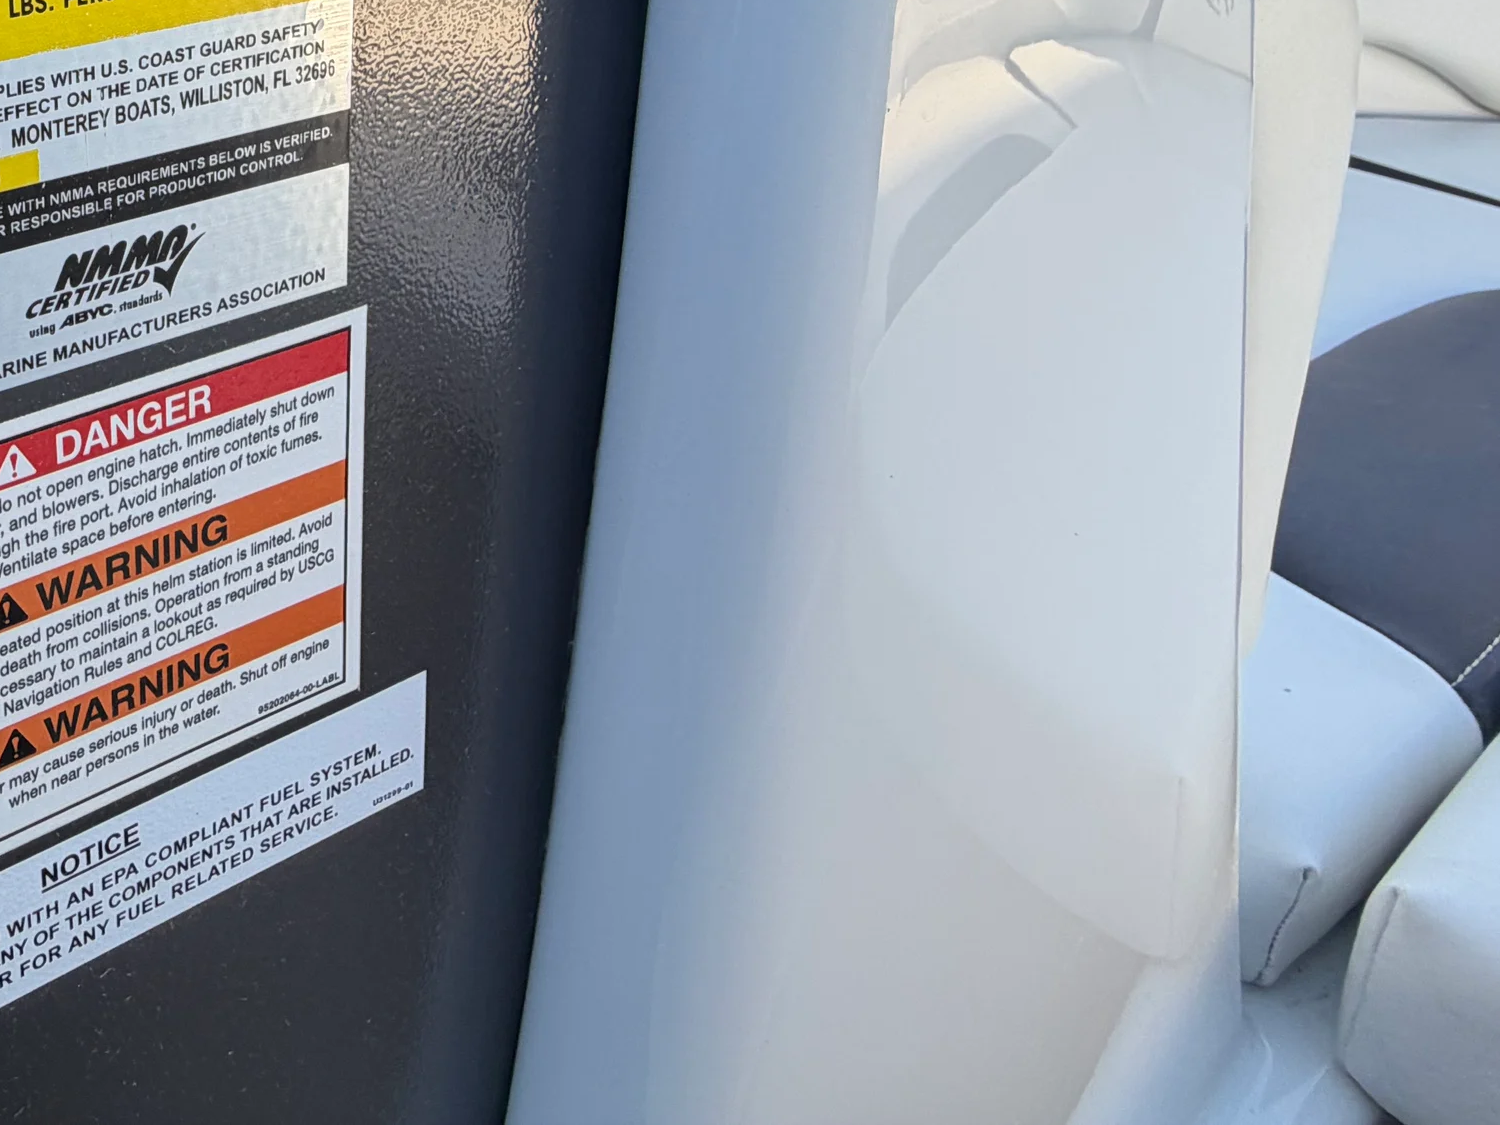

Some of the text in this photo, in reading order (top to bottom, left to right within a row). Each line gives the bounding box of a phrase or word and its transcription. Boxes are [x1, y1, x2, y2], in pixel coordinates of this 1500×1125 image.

[50, 66, 95, 88] WITH
[101, 59, 133, 78] U.S.
[138, 45, 195, 70] COAST
[200, 34, 256, 57] GUARD
[261, 20, 322, 44] SAFETY
[67, 90, 92, 107] ON
[97, 81, 130, 101] THE
[136, 68, 179, 92] DATE
[184, 65, 206, 83] OF
[210, 39, 325, 77] CERTIFICATION
[11, 108, 109, 148] MONTEREY
[115, 95, 175, 124] BOATS,
[180, 74, 268, 110] WILLISTON,
[273, 70, 292, 90] FL
[295, 59, 336, 84] 32696
[7, 197, 45, 217] WITH
[50, 186, 95, 206] NMMA
[97, 157, 206, 194] REQUIREMENTS
[209, 144, 257, 166] BELOW
[259, 140, 272, 154] IS
[274, 126, 333, 150] VERIFIED.
[10, 198, 112, 233] RESPONSIBLE
[116, 190, 145, 207] FOR
[149, 166, 236, 199] PRODUCTION
[239, 152, 304, 175] CONTROL.
[25, 267, 150, 319] CERTIFIED
[53, 224, 192, 292] NMMA
[29, 324, 56, 338] using
[119, 291, 163, 311] standards
[53, 302, 212, 363] MANUFACTURERS
[216, 267, 326, 313] ASSOCIATION
[9, 508, 37, 531] and
[42, 489, 104, 519] blowers.
[109, 463, 178, 495] Discharge
[182, 446, 220, 469] entire
[224, 427, 280, 455] contents
[283, 418, 297, 433] of
[299, 410, 319, 426] fire
[17, 486, 42, 507] not
[46, 473, 83, 499] open
[88, 454, 135, 482] engine
[139, 438, 182, 464] hatch.
[187, 408, 266, 448] Immediately
[270, 396, 298, 418] shut
[301, 385, 335, 407] down
[55, 384, 211, 465] DANGER
[35, 514, 228, 611] WARNING
[62, 530, 106, 556] space
[110, 512, 154, 535] before
[158, 489, 216, 514] entering.
[46, 607, 103, 639] position
[106, 599, 121, 615] at
[124, 586, 149, 607] this
[153, 574, 185, 595] helm
[188, 554, 233, 581] station
[236, 549, 247, 563] is
[250, 529, 295, 557] limited.
[298, 512, 333, 538] Avoid
[3, 616, 218, 716] Navigation Rules and COLREG.
[8, 767, 40, 790] may
[43, 747, 85, 774] cause
[88, 724, 138, 751] serious
[141, 706, 177, 730] injury
[180, 699, 194, 712] or
[197, 681, 236, 705] death.
[240, 663, 268, 686] Shut
[271, 654, 288, 672] off
[290, 638, 330, 664] engine
[43, 642, 230, 744] WARNING
[8, 704, 221, 809] when near persons in the water.
[6, 900, 59, 938] WITH
[66, 882, 94, 910] AN
[101, 863, 139, 891] EPA
[145, 803, 254, 868] COMPLIANT
[259, 781, 305, 813] FUEL
[309, 743, 381, 787] SYSTEM.
[33, 922, 60, 947] OF
[64, 900, 104, 930] THE
[108, 834, 235, 909] COMPONENTS
[239, 811, 283, 842] THAT
[287, 791, 321, 820] ARE
[326, 747, 414, 801] INSTALLED.
[40, 823, 140, 888] NOTICE
[19, 945, 62, 978] FOR
[68, 919, 110, 953] ANY
[116, 895, 165, 928] FUEL
[171, 847, 254, 899] RELATED
[260, 805, 339, 853] SERVICE.
